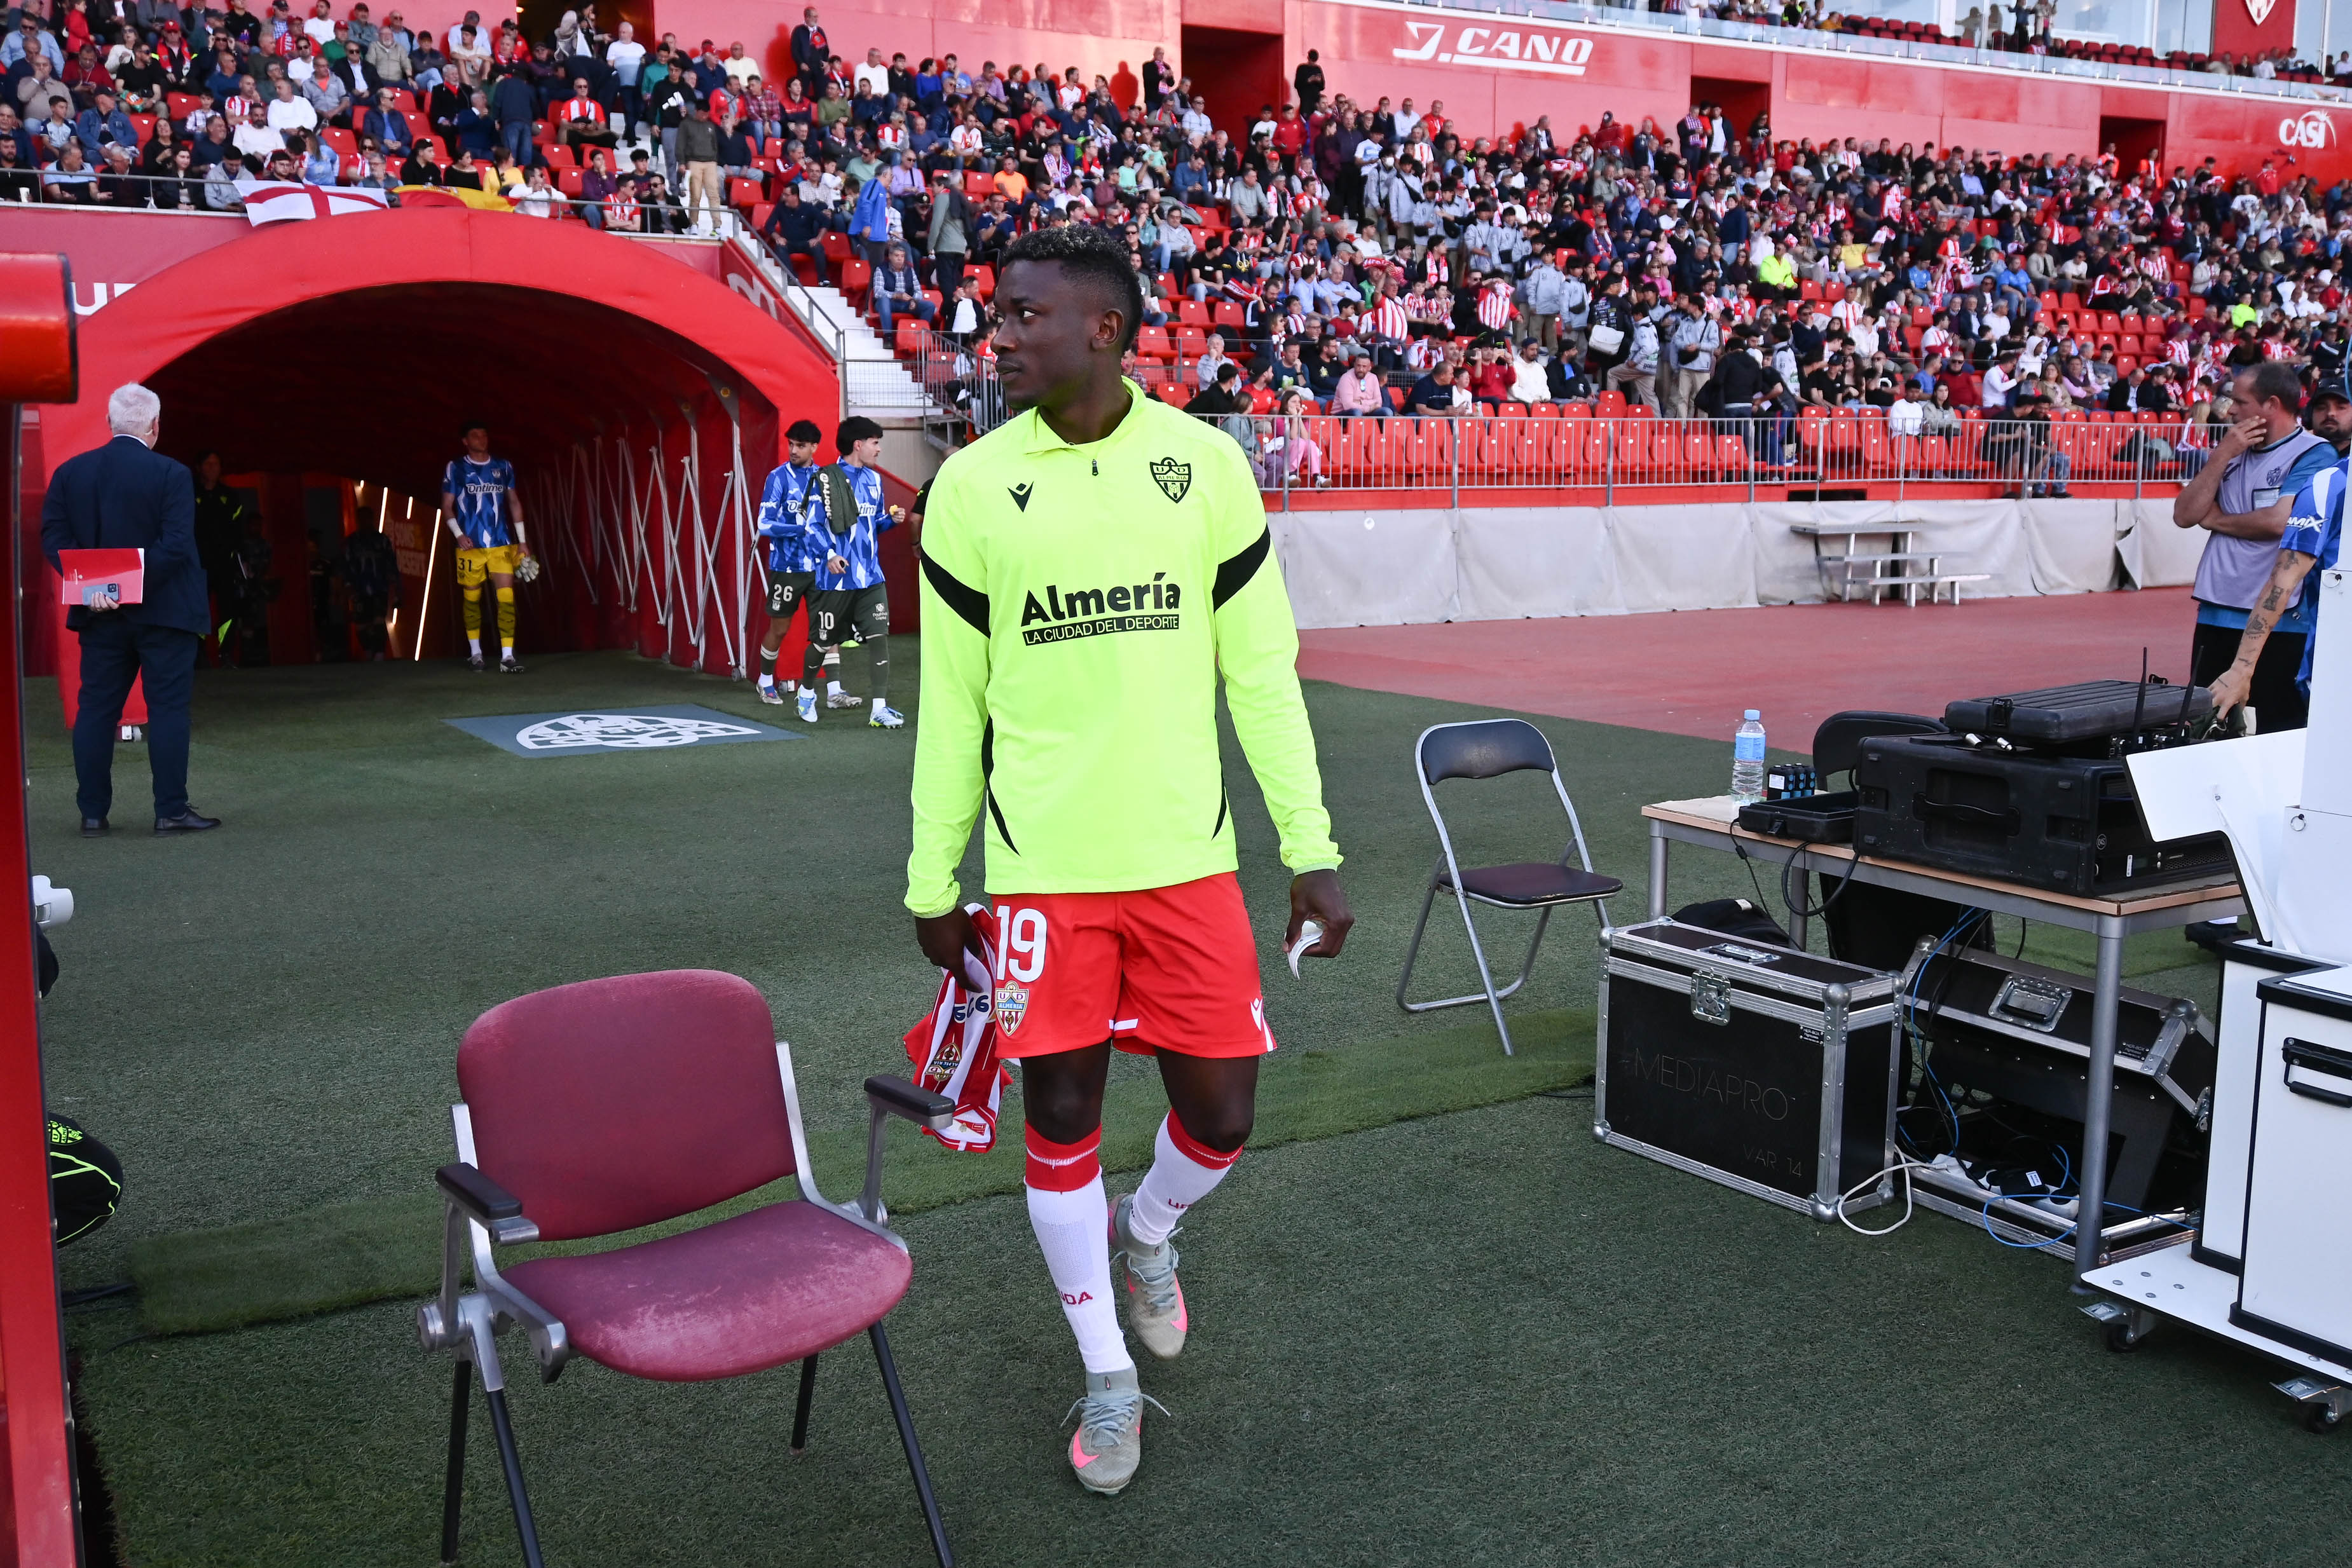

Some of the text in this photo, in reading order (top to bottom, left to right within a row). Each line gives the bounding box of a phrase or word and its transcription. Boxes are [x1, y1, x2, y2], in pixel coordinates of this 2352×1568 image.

[2279, 118, 2327, 149] CASI
[467, 482, 503, 494] Ontime
[458, 557, 472, 572] 31
[774, 583, 793, 602] 26
[1020, 572, 1181, 627] Almería
[818, 611, 835, 630] 10
[1025, 616, 1179, 644] LA CIUDAD DEL DEPORTE
[996, 904, 1048, 983] 19
[1636, 1047, 1788, 1121] MEDIAPRO
[1743, 1144, 1802, 1177] VAR 14
